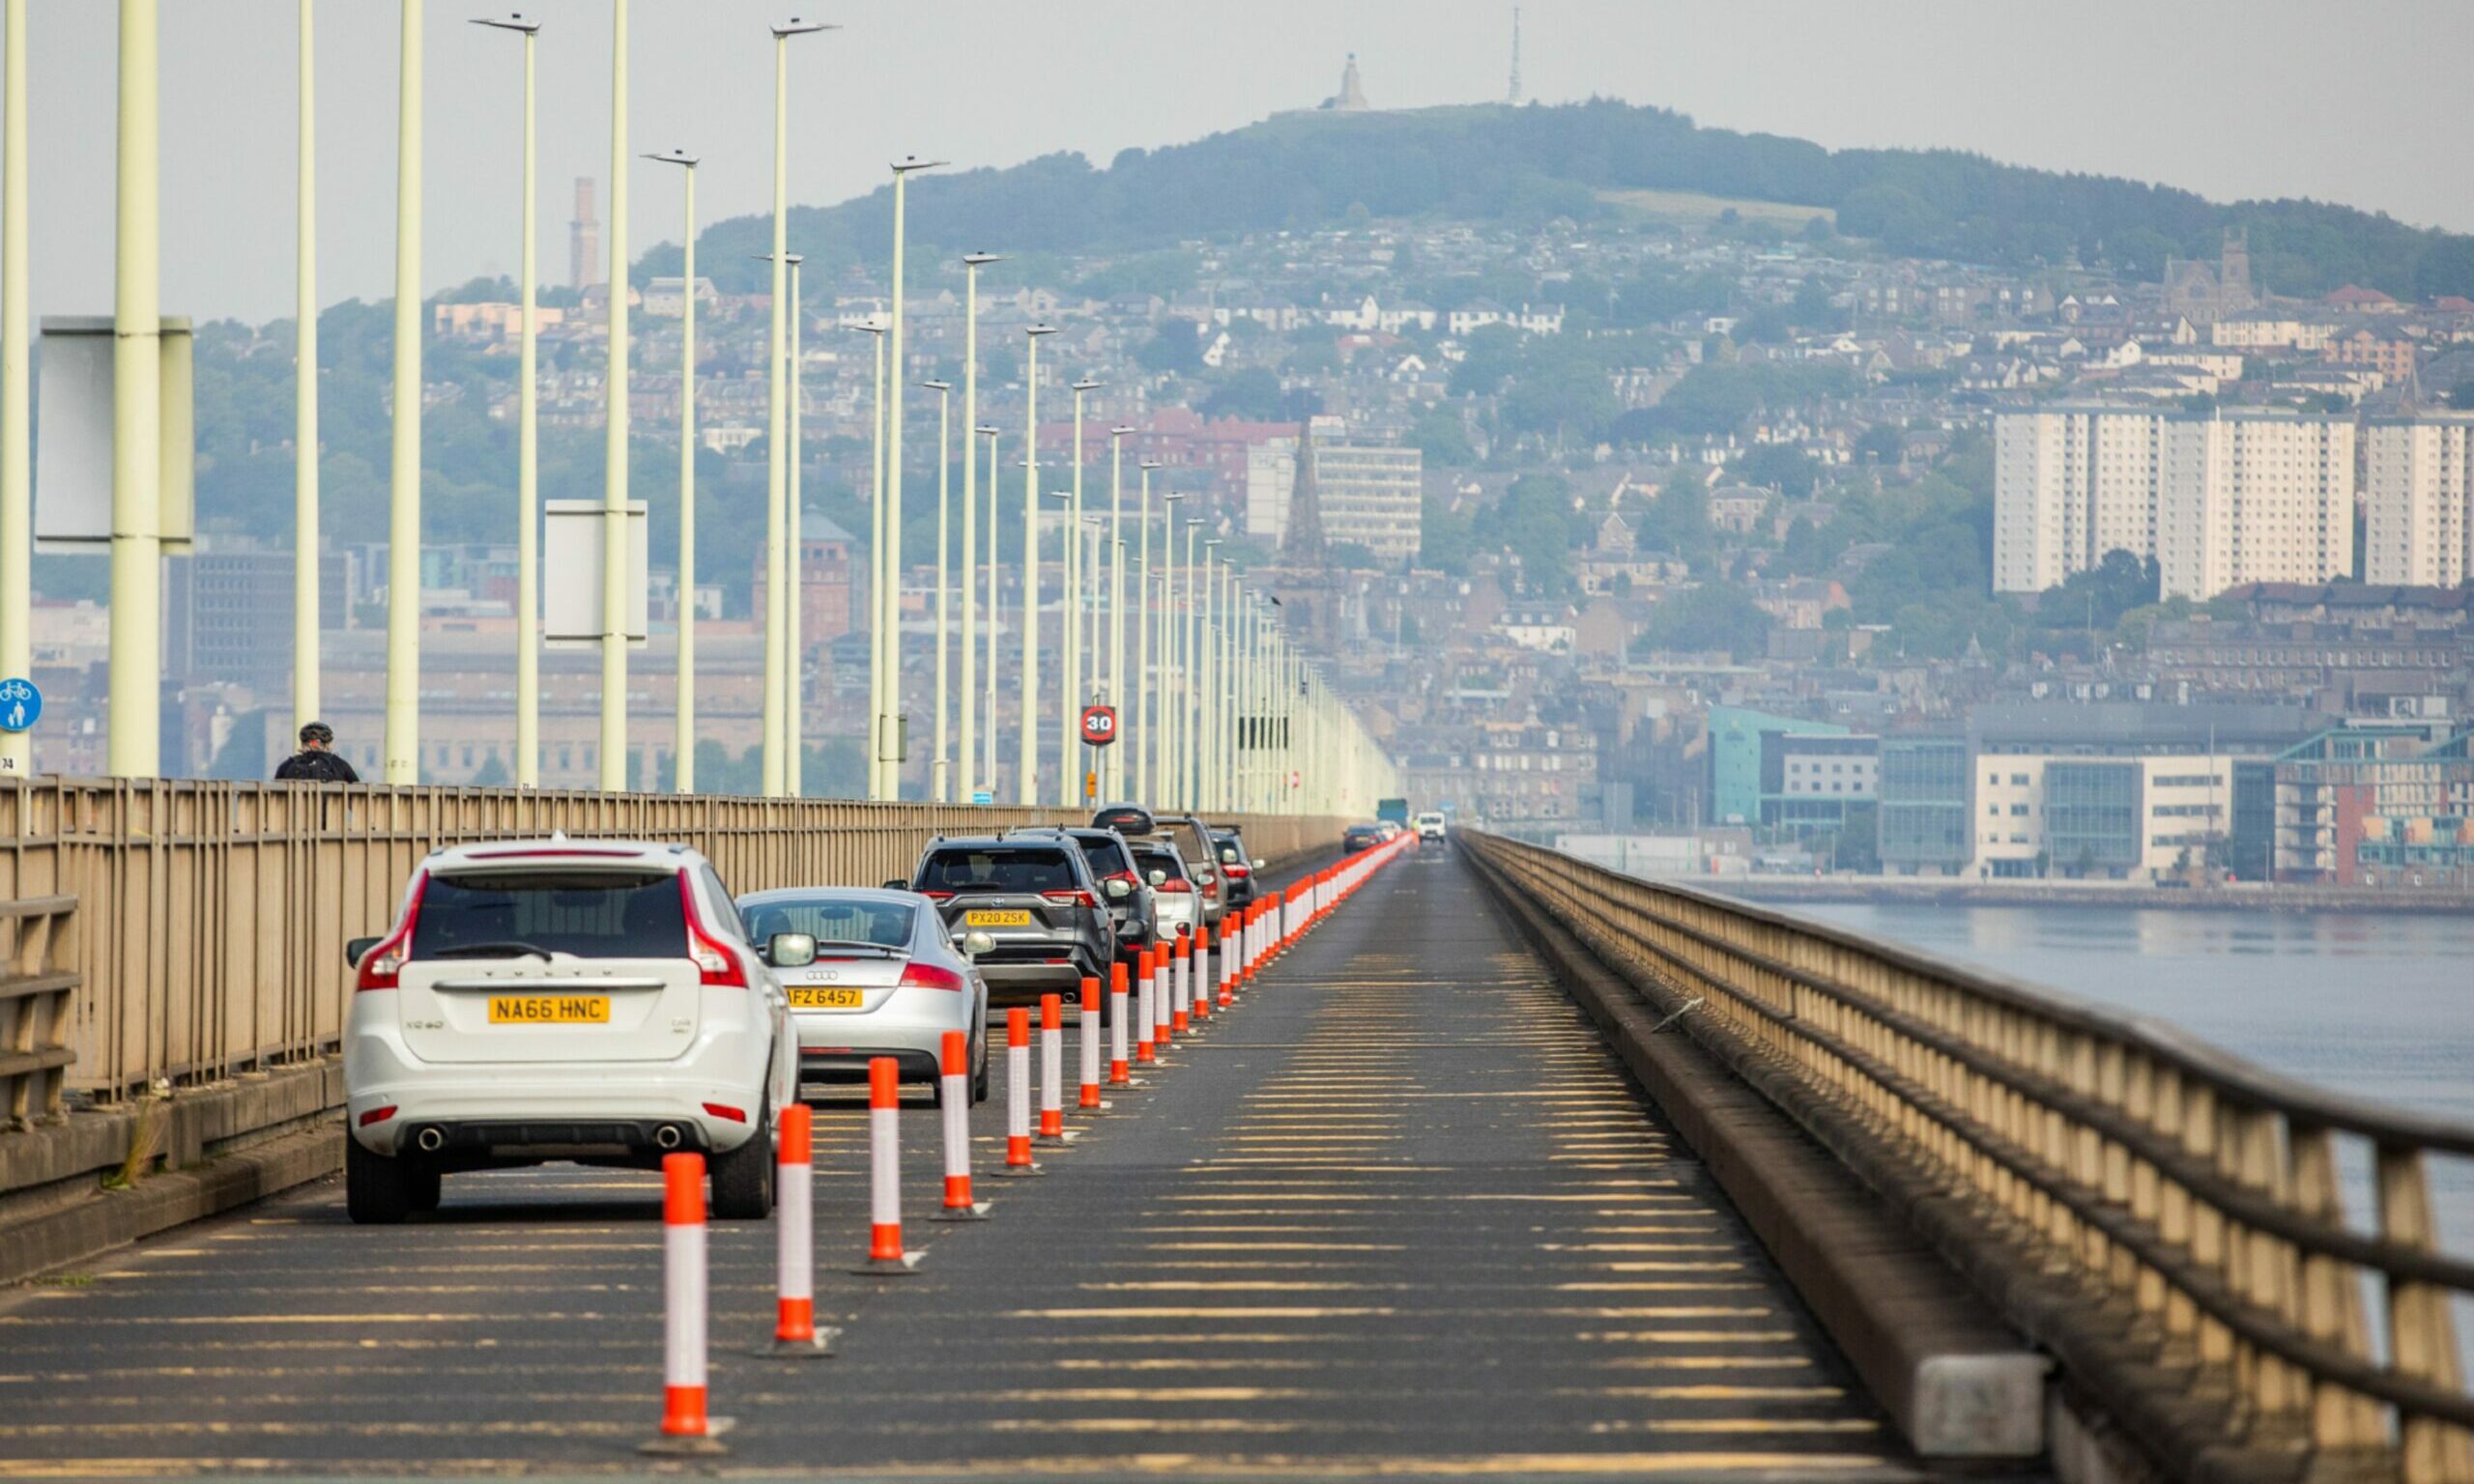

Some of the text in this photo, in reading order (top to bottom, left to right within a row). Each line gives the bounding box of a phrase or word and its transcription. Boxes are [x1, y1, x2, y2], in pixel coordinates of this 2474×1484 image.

[1087, 716, 1112, 730] 30
[970, 912, 1025, 924] PX20 ZSK
[816, 989, 857, 1004] 6457
[496, 999, 601, 1018] NA66 HNC
